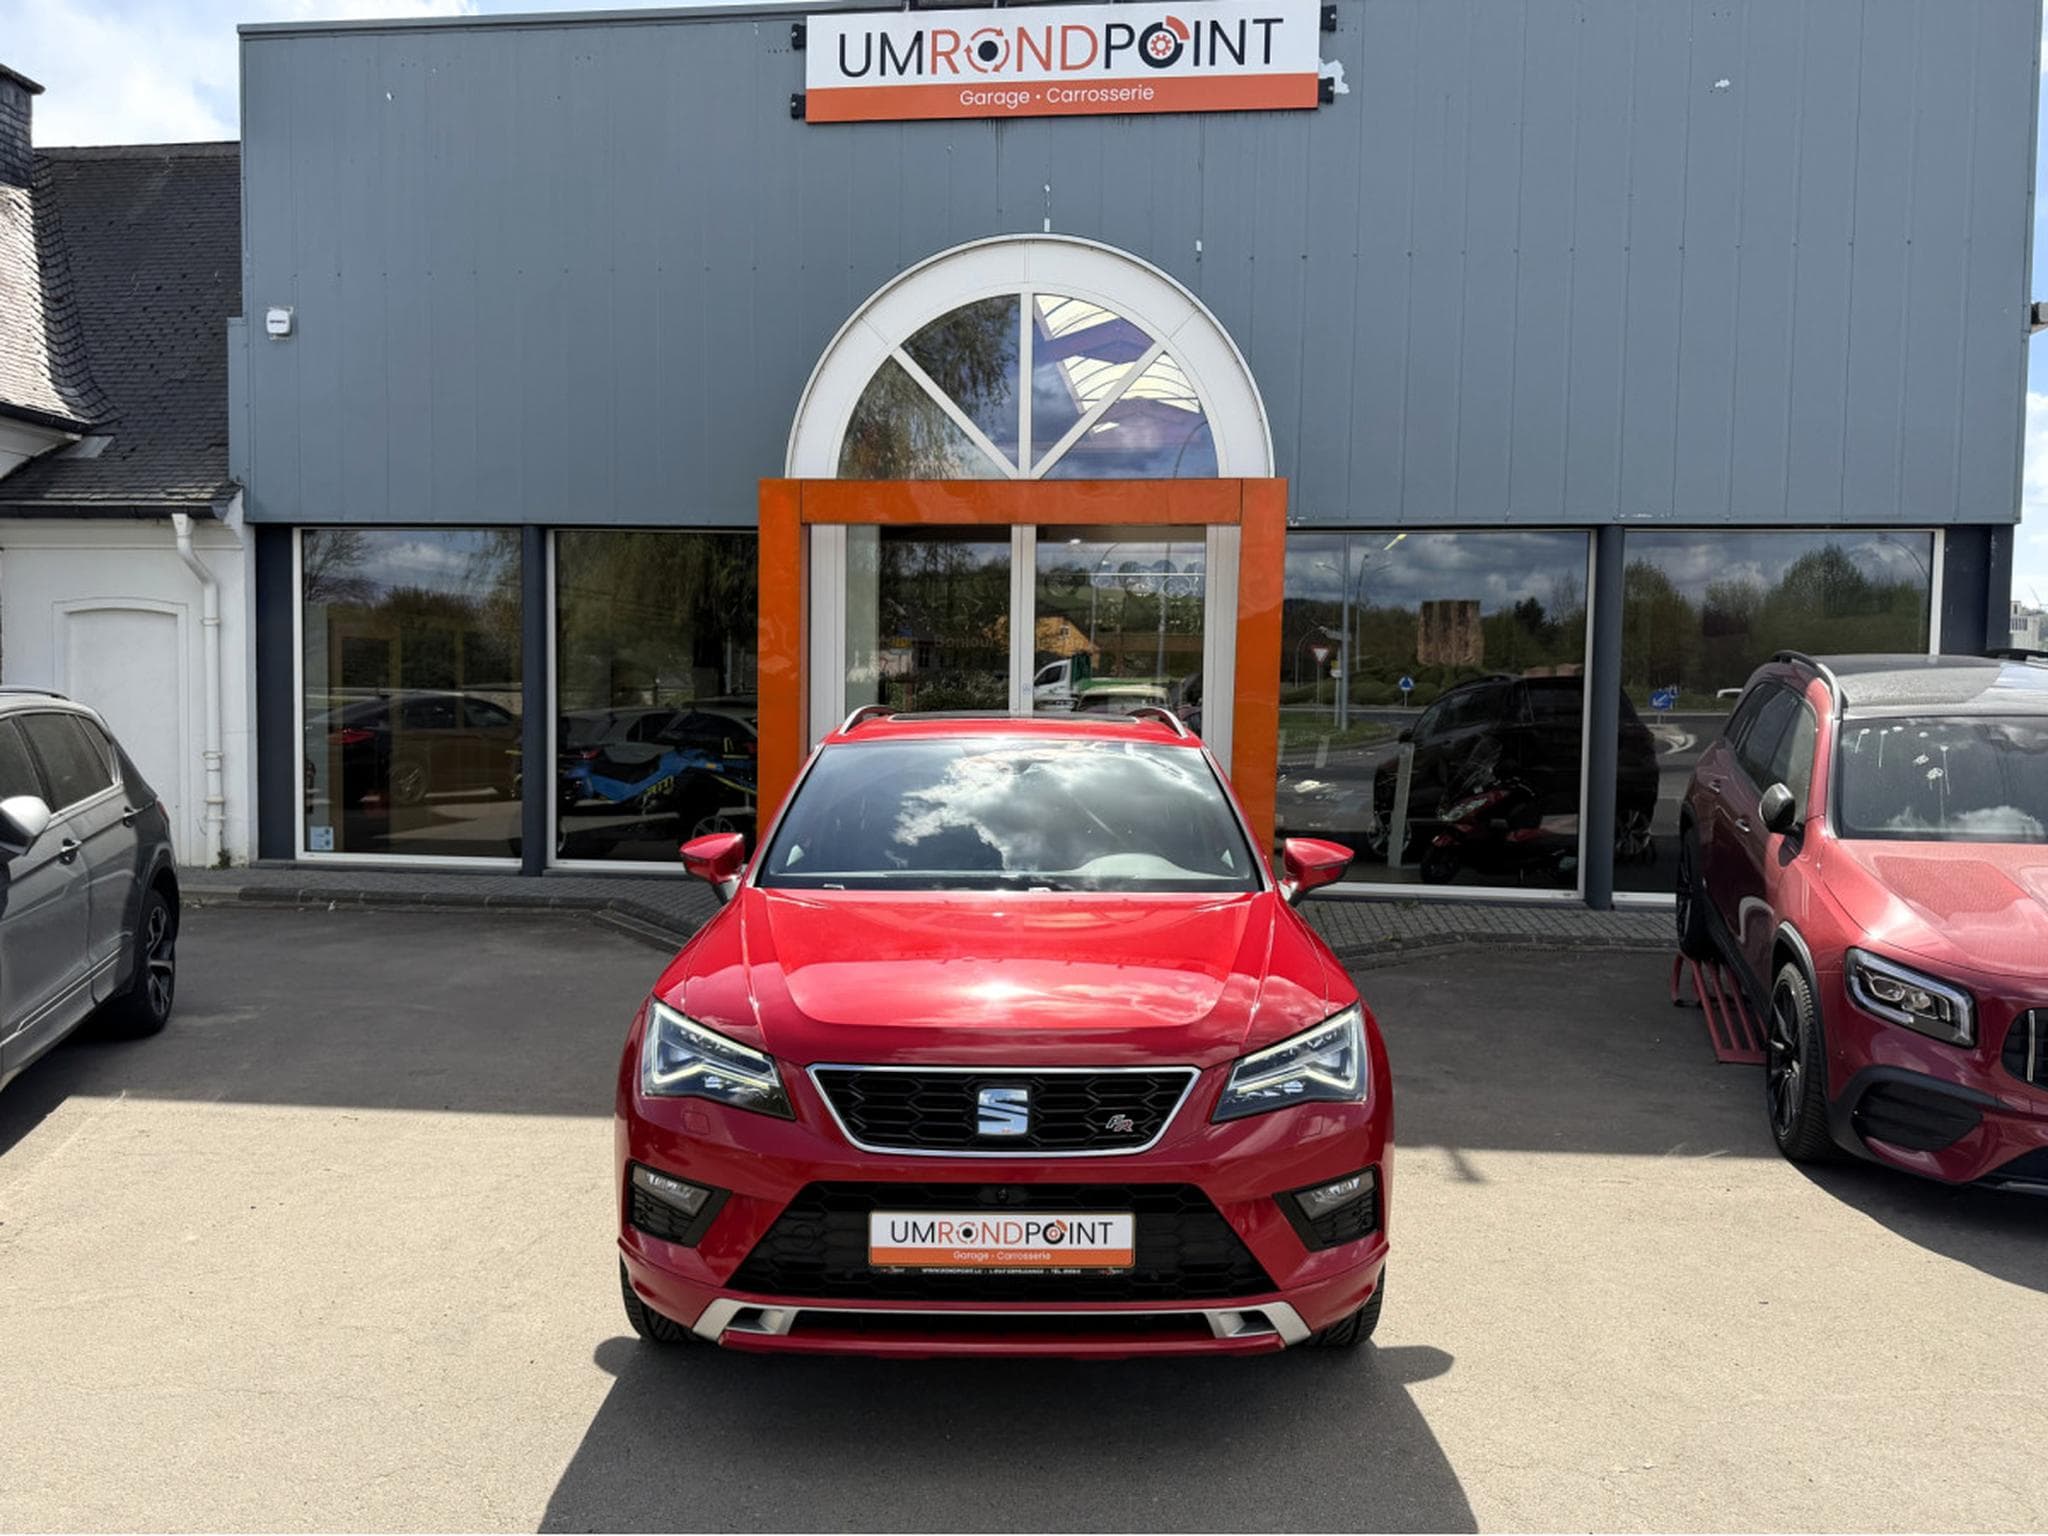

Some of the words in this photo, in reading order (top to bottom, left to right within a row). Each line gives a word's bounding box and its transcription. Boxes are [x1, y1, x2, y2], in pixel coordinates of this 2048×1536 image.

[959, 89, 1030, 108] Garage
[1046, 85, 1155, 103] Carrosserie
[953, 1251, 989, 1261] Garage
[996, 1250, 1052, 1260] Carrosserie
